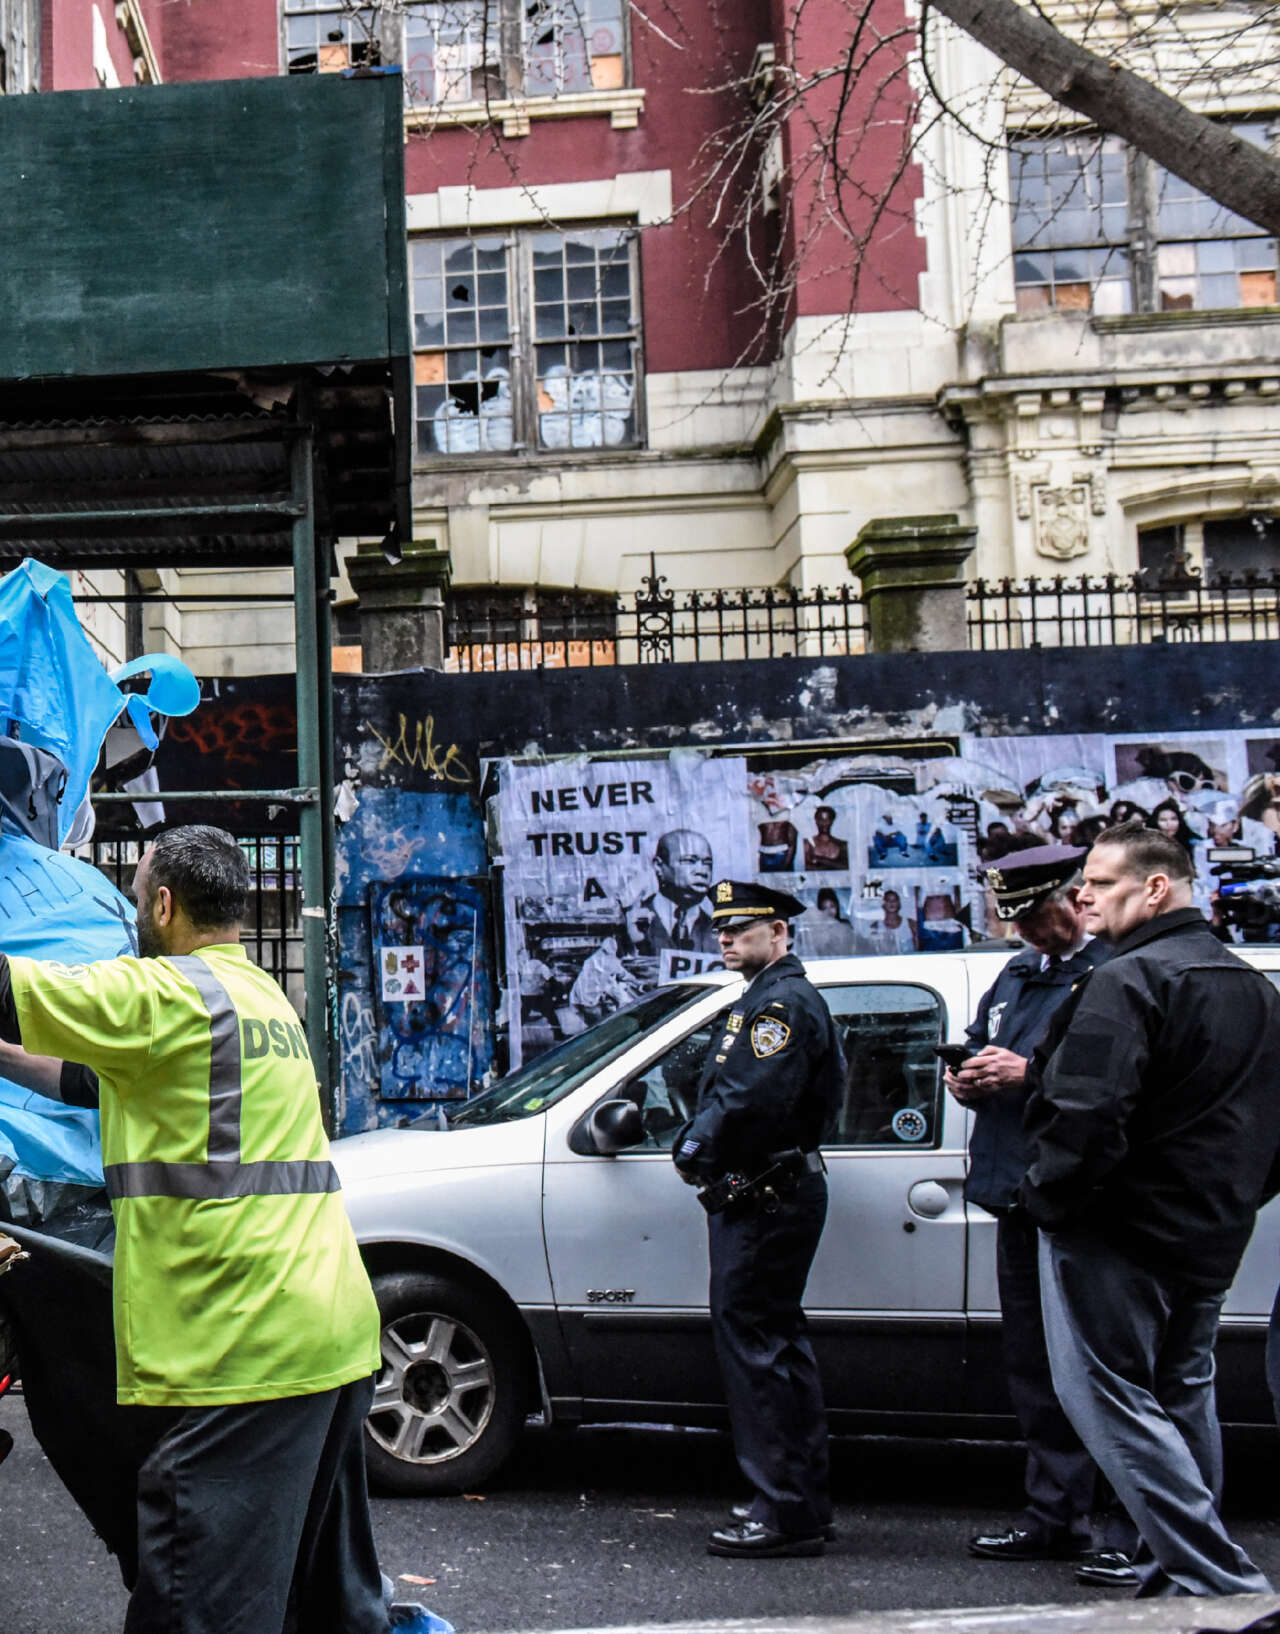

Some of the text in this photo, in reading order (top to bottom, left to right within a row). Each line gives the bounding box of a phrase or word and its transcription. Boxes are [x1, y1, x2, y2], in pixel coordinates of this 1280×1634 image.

[531, 781, 655, 814] NEVER
[526, 831, 647, 857] TRUST
[583, 877, 608, 902] A
[242, 1018, 309, 1060] DSN
[586, 1289, 635, 1302] SPORT
